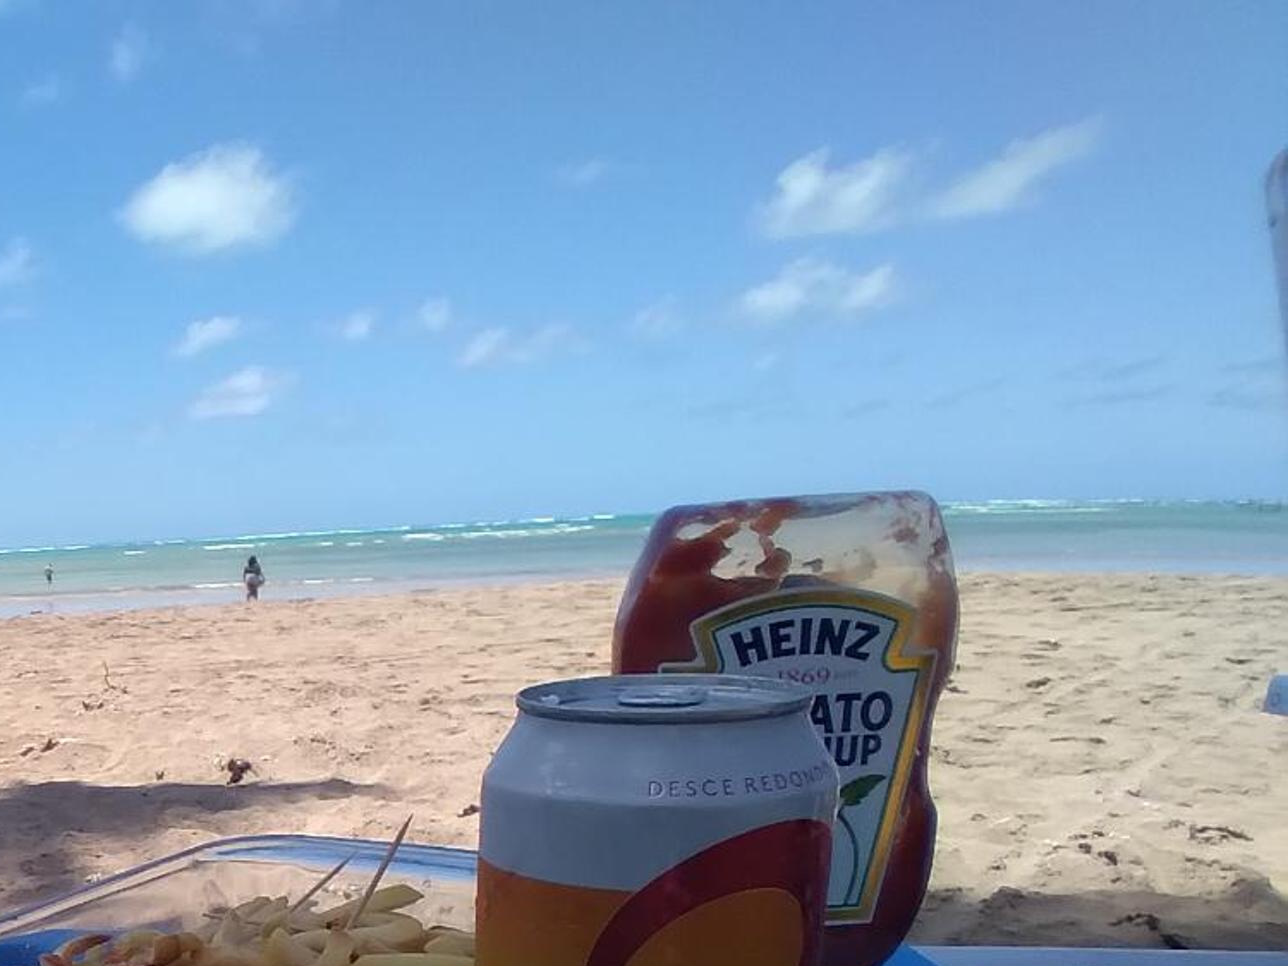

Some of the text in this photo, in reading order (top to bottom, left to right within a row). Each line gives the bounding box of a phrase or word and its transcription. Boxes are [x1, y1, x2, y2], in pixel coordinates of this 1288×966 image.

[730, 618, 881, 667] HEINZ
[810, 691, 893, 734] ATO
[648, 778, 735, 799] DESCE
